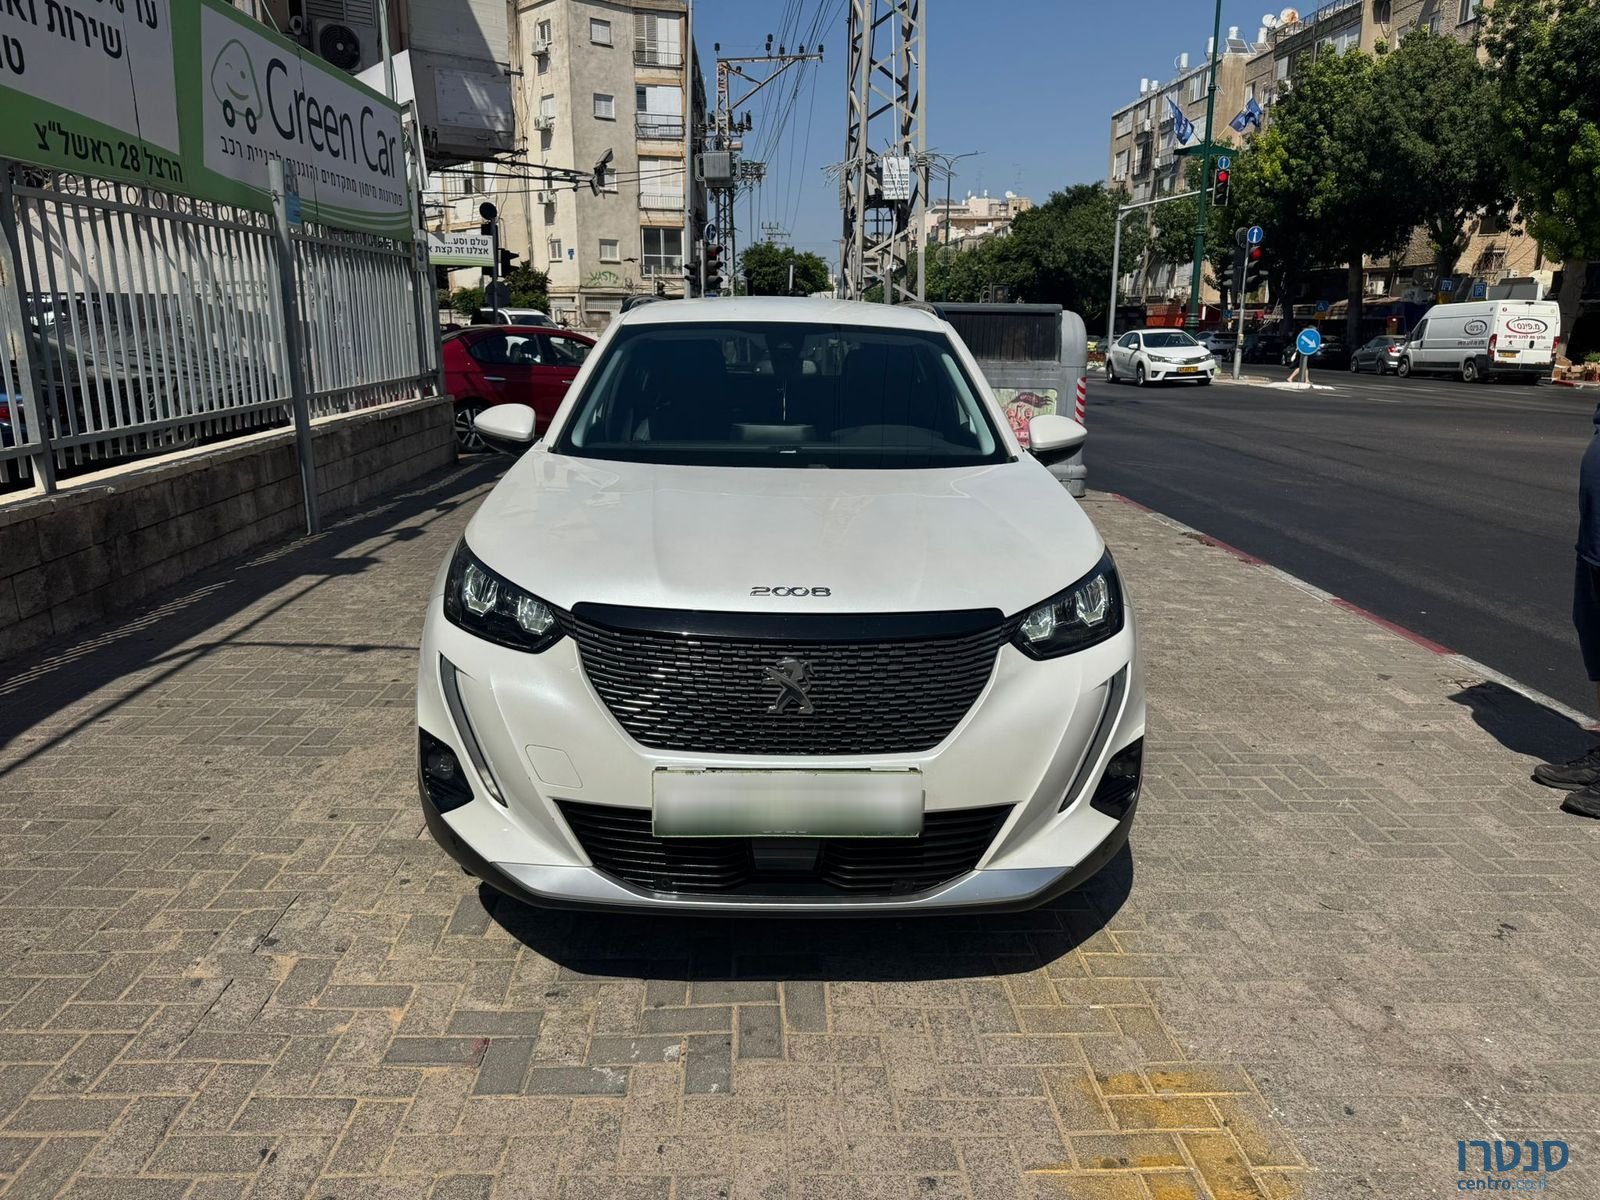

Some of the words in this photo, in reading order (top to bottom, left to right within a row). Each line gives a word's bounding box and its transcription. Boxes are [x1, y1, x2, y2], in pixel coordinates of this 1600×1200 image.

[46, 0, 122, 59] שירות
[266, 58, 357, 164] Green
[360, 105, 397, 179] Car
[117, 141, 141, 172] 28
[220, 135, 243, 158] רכב
[143, 146, 183, 183] הרצל
[321, 168, 357, 193] מתקדמים
[359, 180, 377, 198] מימון
[378, 186, 403, 206] פתרונות
[434, 246, 453, 255] קצת
[466, 246, 489, 255] אצלנו
[470, 237, 488, 246] שלם
[750, 586, 831, 597] 2008
